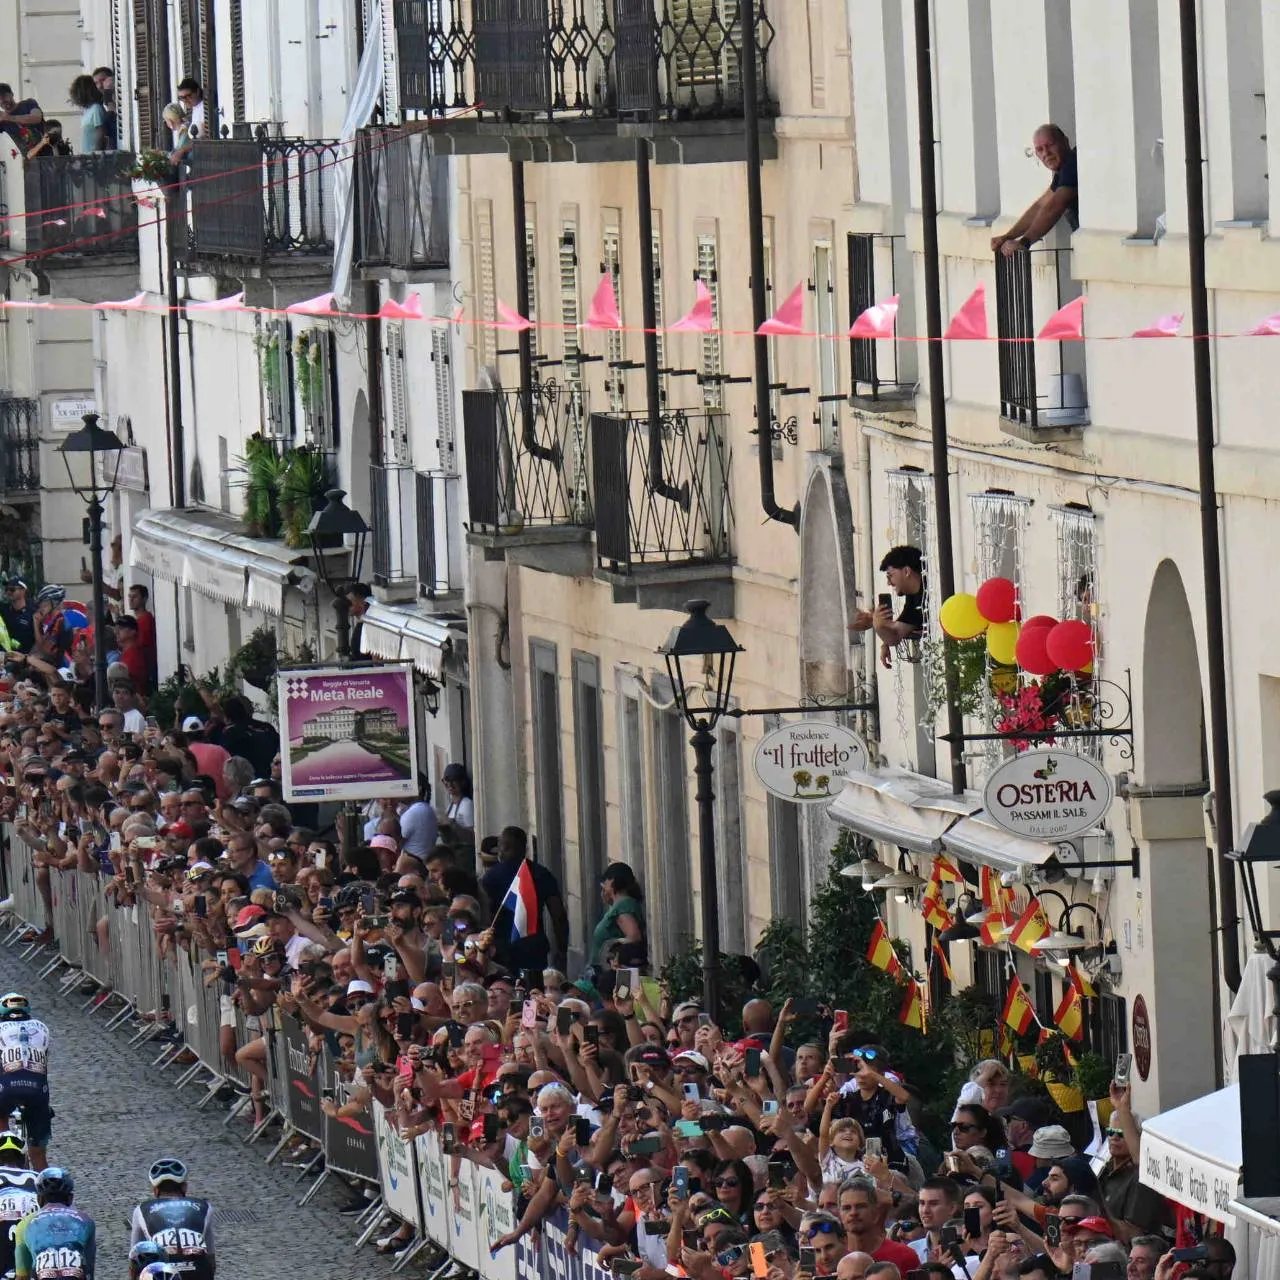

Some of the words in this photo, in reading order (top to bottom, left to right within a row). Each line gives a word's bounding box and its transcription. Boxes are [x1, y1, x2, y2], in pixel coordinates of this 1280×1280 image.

[310, 689, 344, 702] Meta
[347, 686, 384, 700] Reale
[997, 780, 1096, 807] OSTERIA
[1010, 810, 1051, 821] PASSAMI
[1063, 808, 1088, 818] SALE
